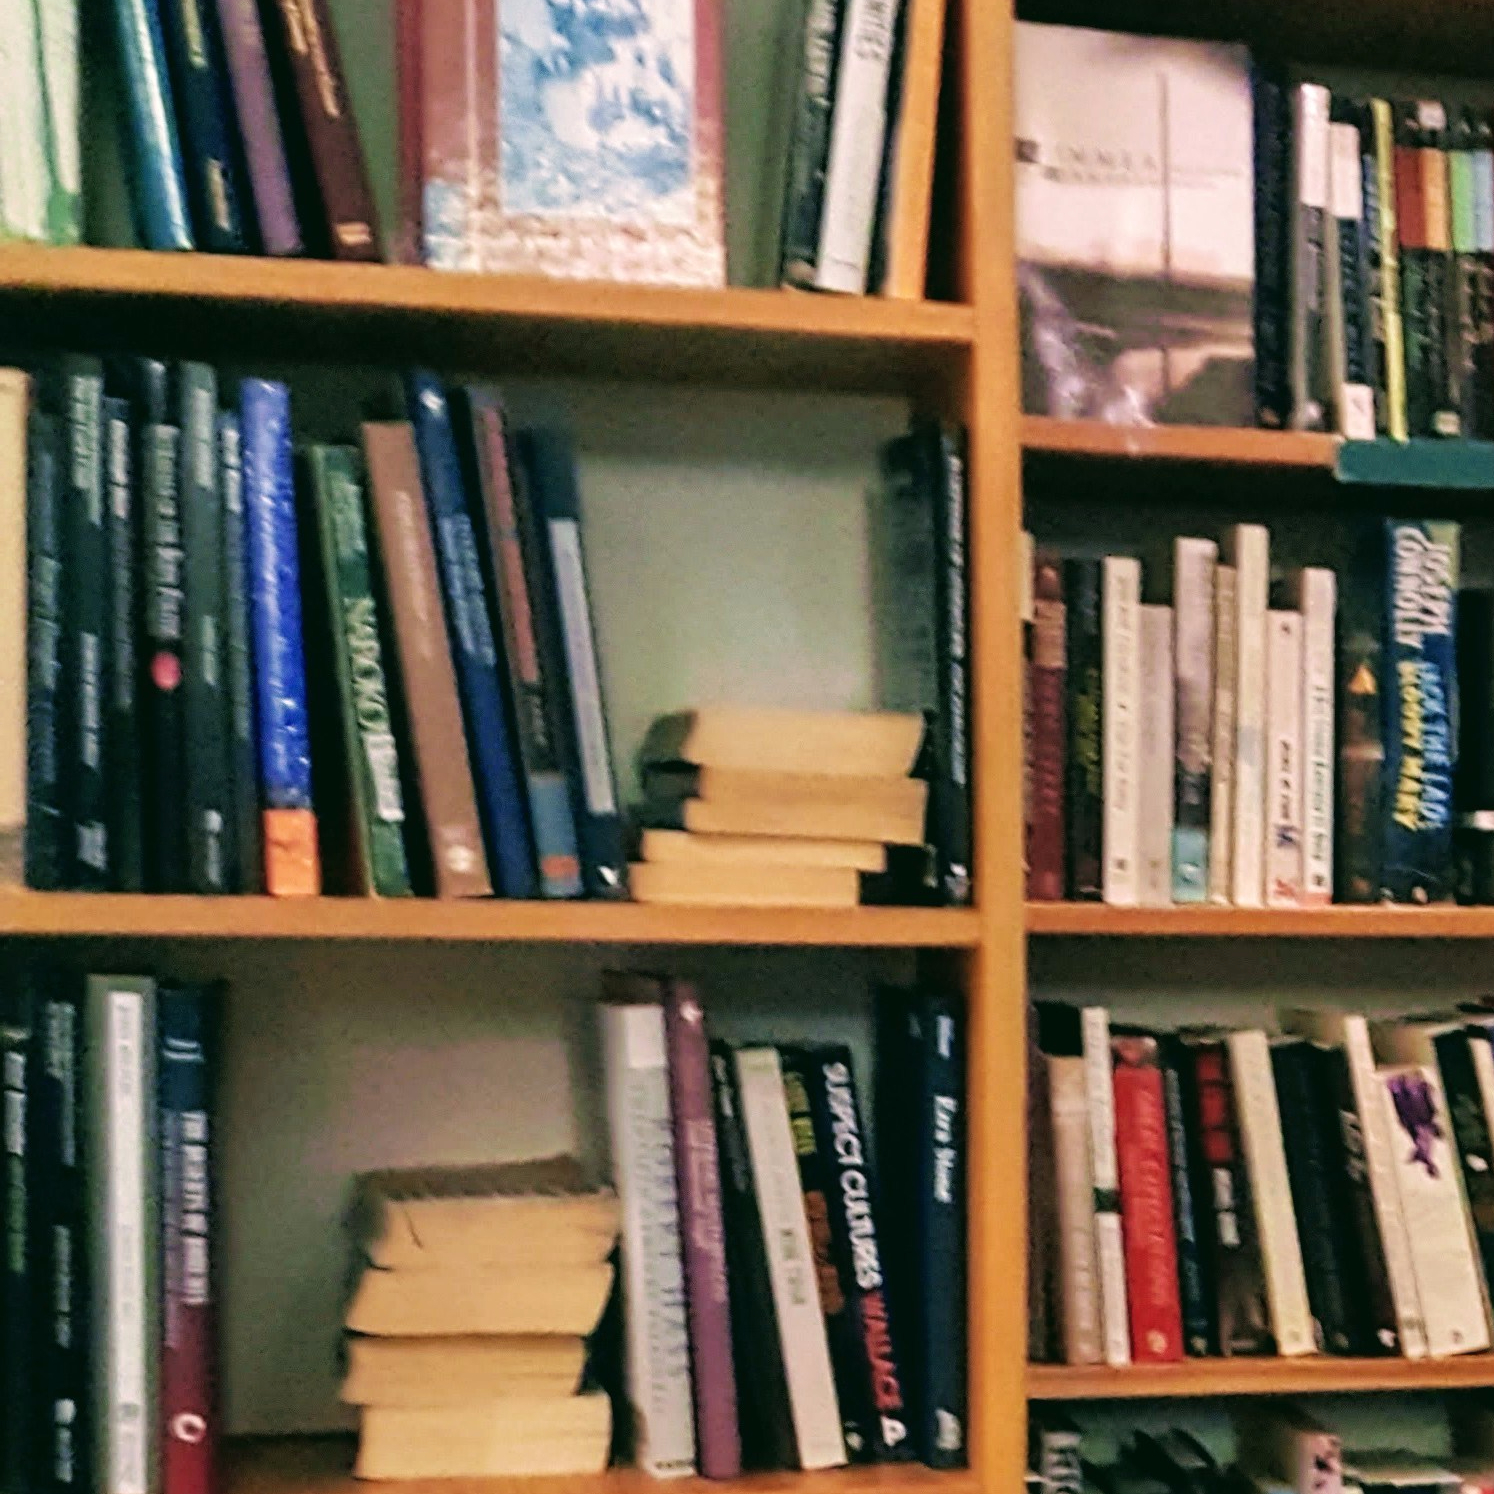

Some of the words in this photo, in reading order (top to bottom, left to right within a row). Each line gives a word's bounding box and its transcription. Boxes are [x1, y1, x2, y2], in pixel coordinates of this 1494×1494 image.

[1394, 526, 1424, 648] CONNOLLY
[1392, 755, 1423, 832] MARY
[1421, 722, 1446, 766] THE
[821, 1061, 863, 1166] SUSPECT
[839, 1168, 885, 1291] CULTURES
[859, 1290, 905, 1410] WALLACE
